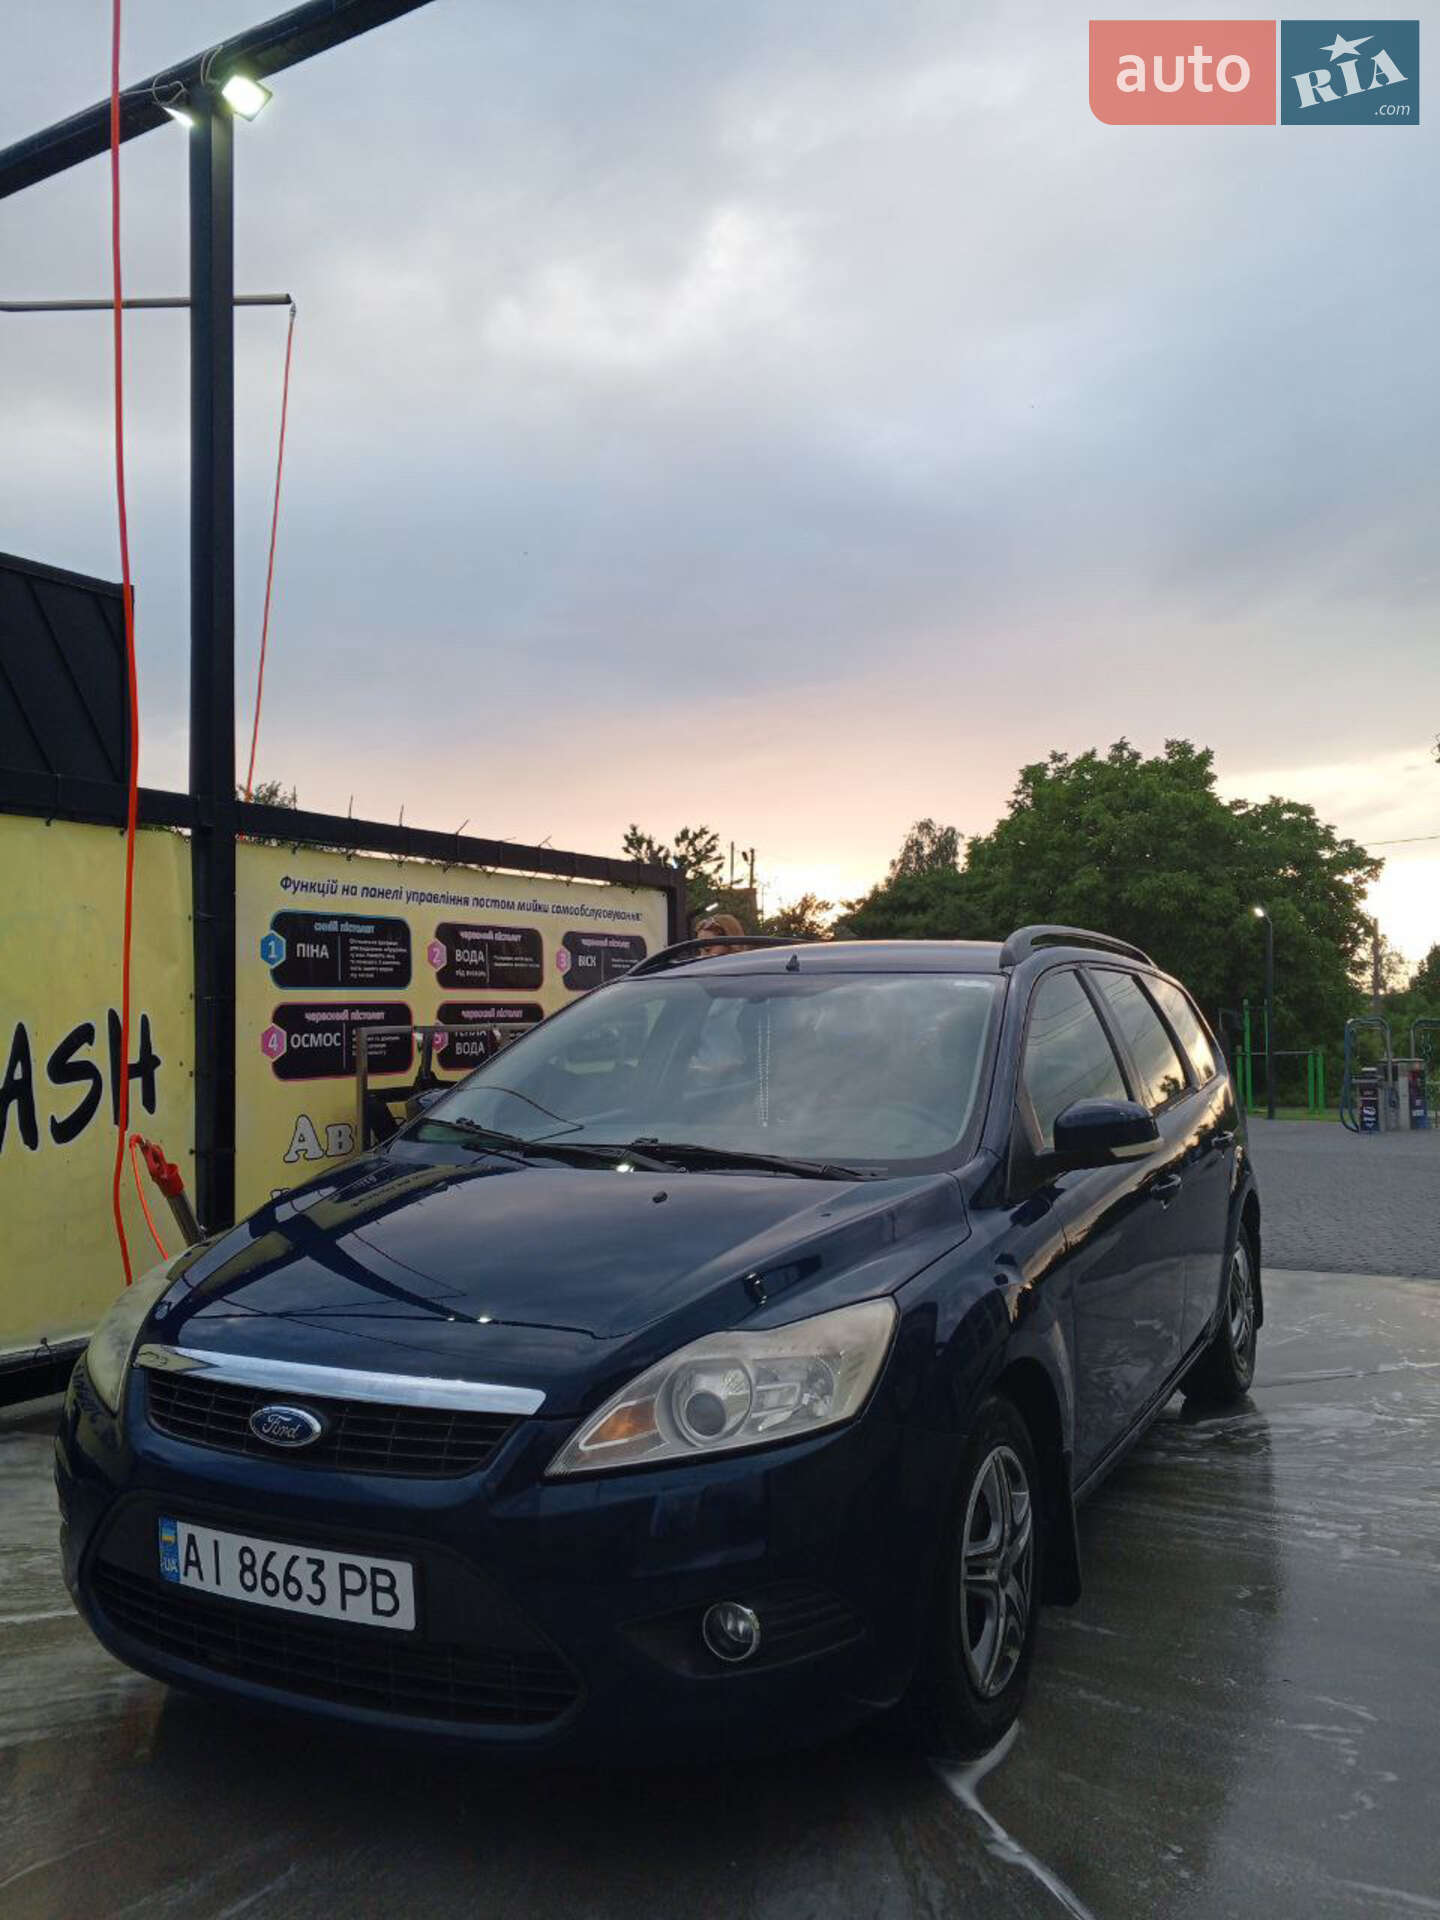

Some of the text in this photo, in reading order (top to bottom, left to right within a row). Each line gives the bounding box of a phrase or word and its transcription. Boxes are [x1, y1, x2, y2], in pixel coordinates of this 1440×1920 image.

[279, 875, 338, 898] Функцій
[341, 885, 358, 897] на
[361, 886, 403, 900] панелі
[405, 890, 470, 907] управління
[471, 896, 516, 911] постом
[517, 899, 549, 914] мийки
[267, 940, 277, 960] 1
[296, 942, 330, 959] ПІНА
[432, 947, 441, 964] 2
[455, 948, 485, 966] ВОДА
[558, 951, 567, 969] 3
[268, 1033, 278, 1052] 4
[290, 1032, 342, 1049] ОСМОС
[455, 1041, 486, 1057] ВОДА
[261, 1412, 301, 1440] Ford
[238, 1545, 327, 1607] 8663
[338, 1561, 401, 1618] PB
